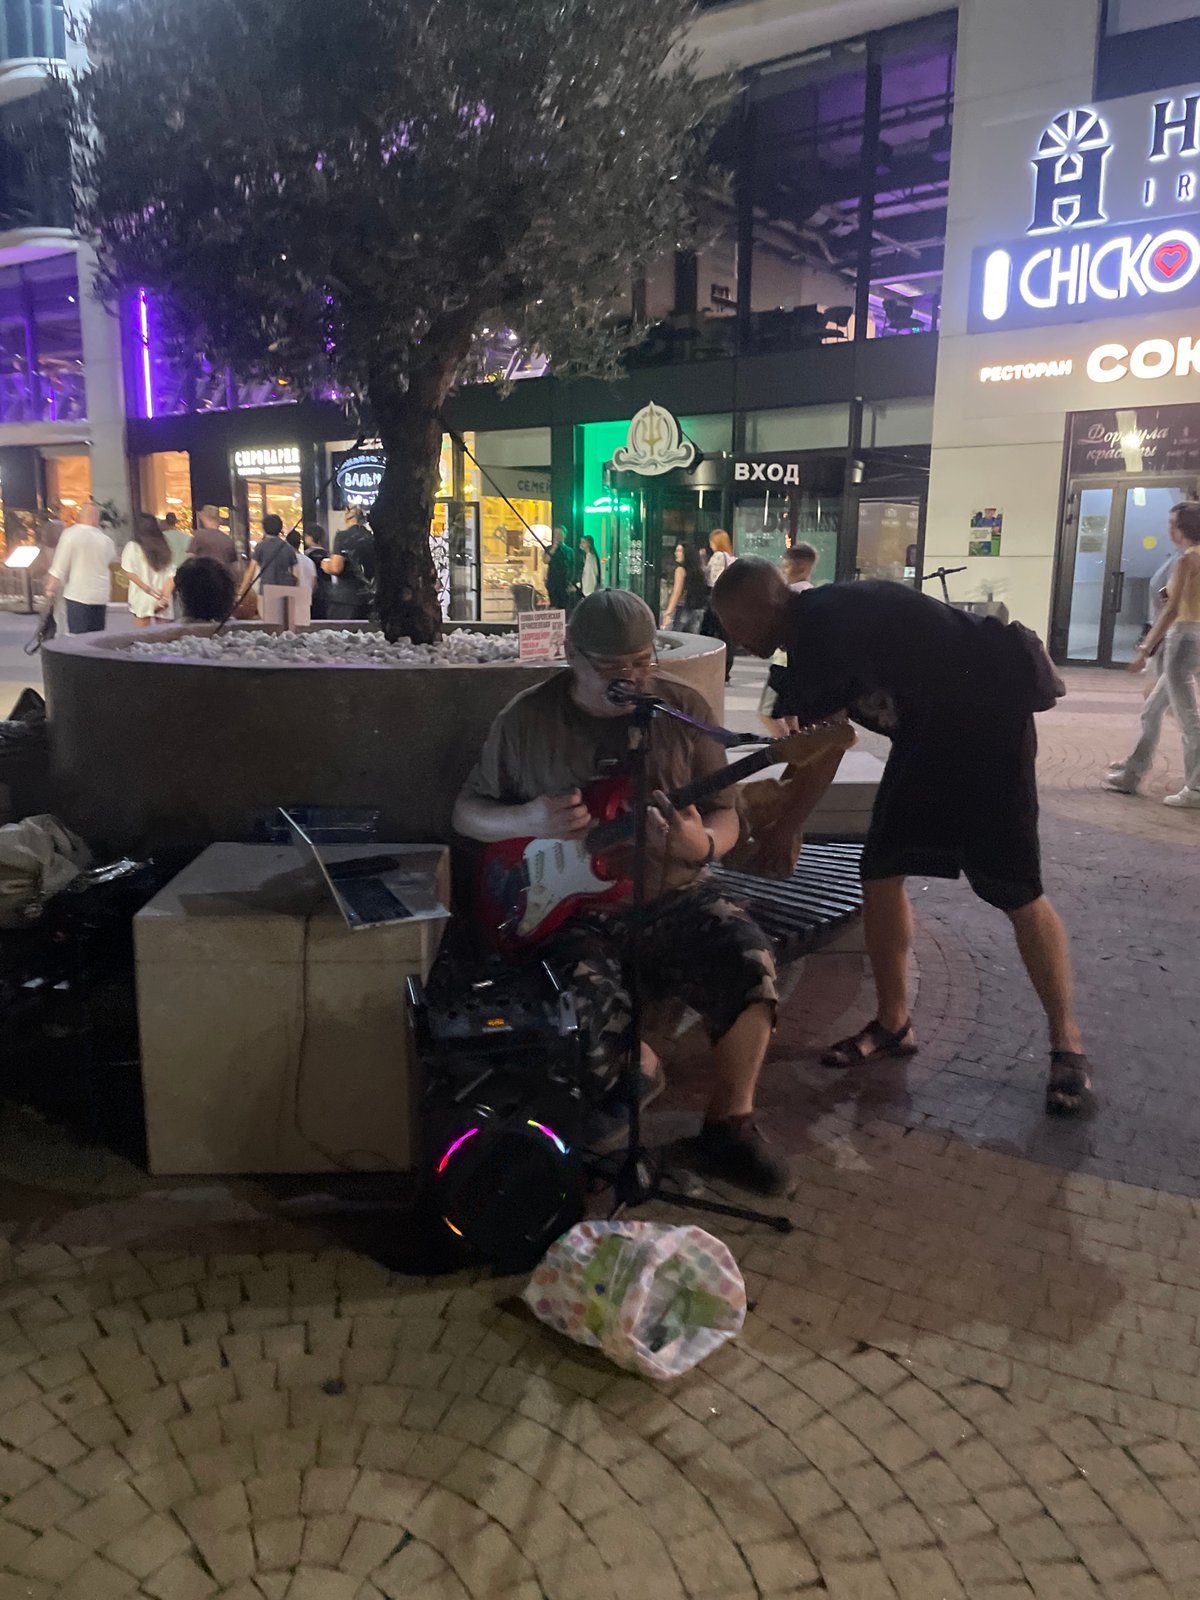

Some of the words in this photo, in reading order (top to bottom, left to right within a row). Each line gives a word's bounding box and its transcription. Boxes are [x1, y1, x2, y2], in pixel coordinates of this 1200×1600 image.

[1019, 229, 1200, 308] CHICKO
[980, 359, 1073, 382] РЕСТОРАН
[1078, 423, 1169, 448] Форула
[734, 462, 800, 486] ВХОД
